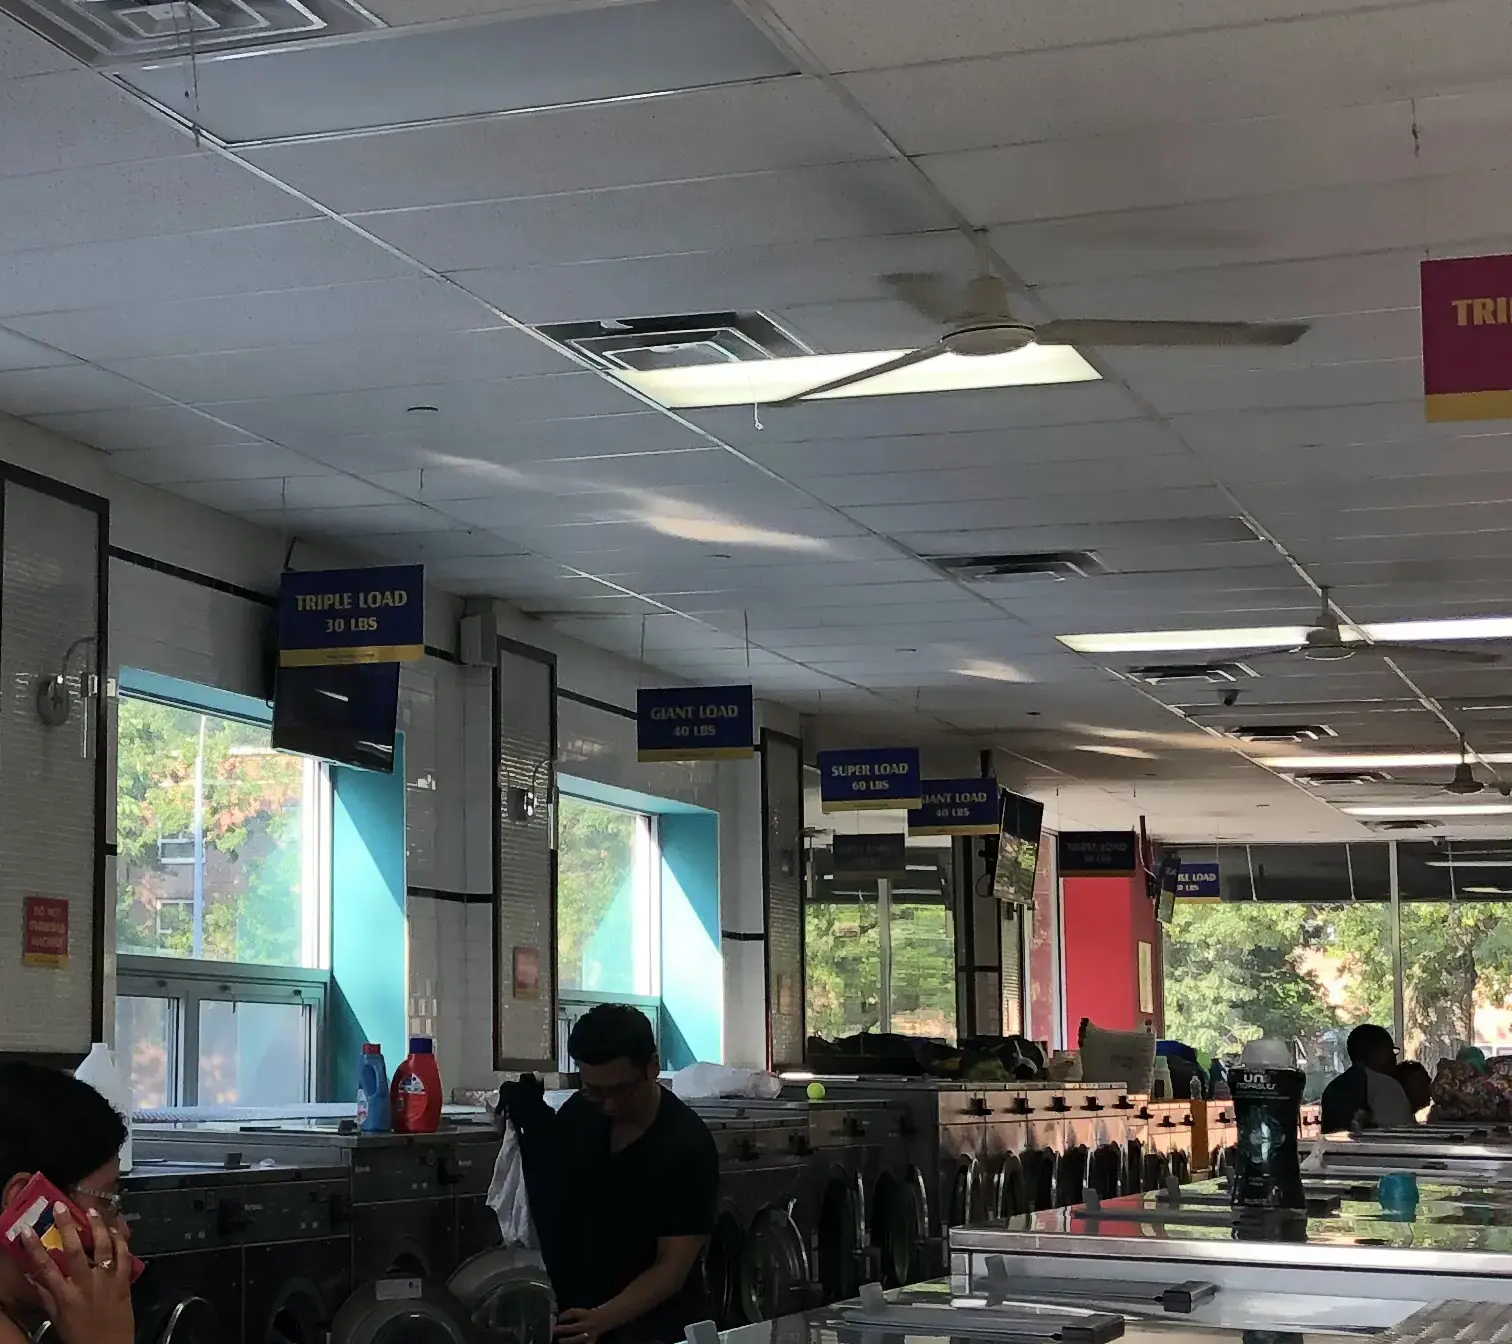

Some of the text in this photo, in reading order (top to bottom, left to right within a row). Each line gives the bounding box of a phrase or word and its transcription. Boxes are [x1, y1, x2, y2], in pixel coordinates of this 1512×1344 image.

[1451, 296, 1512, 327] TRI
[296, 590, 407, 611] TRIPLE LOAD
[325, 617, 378, 632] 30 LBS
[650, 705, 738, 720] GIANT LOAD
[673, 725, 716, 737] 40 LBS
[831, 763, 909, 777] SUPER LOAD
[852, 780, 890, 791] 60 LBS
[956, 792, 987, 803] LOAD
